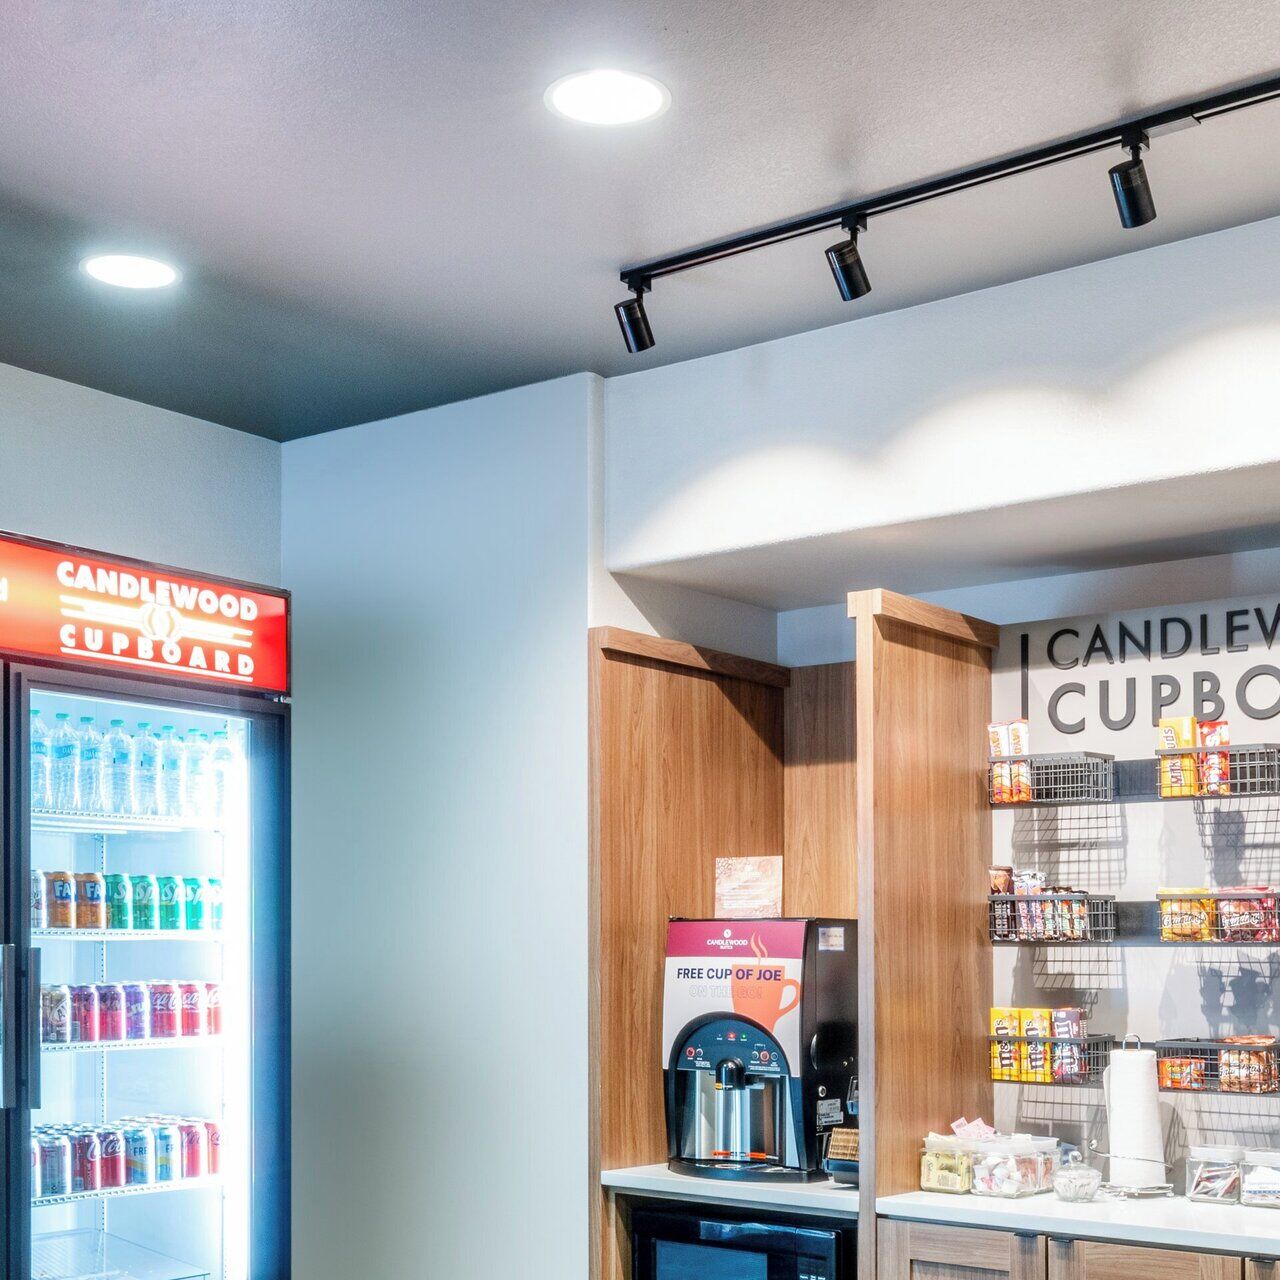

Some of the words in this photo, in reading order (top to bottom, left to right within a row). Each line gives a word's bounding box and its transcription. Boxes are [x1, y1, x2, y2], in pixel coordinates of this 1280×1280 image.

[56, 561, 259, 623] CANDLEWOOD
[60, 622, 255, 677] CUPBOARD
[677, 967, 704, 980] FREE
[706, 967, 733, 980] CUP
[735, 968, 754, 980] OF
[756, 969, 782, 982] JOE
[689, 984, 708, 998] ON
